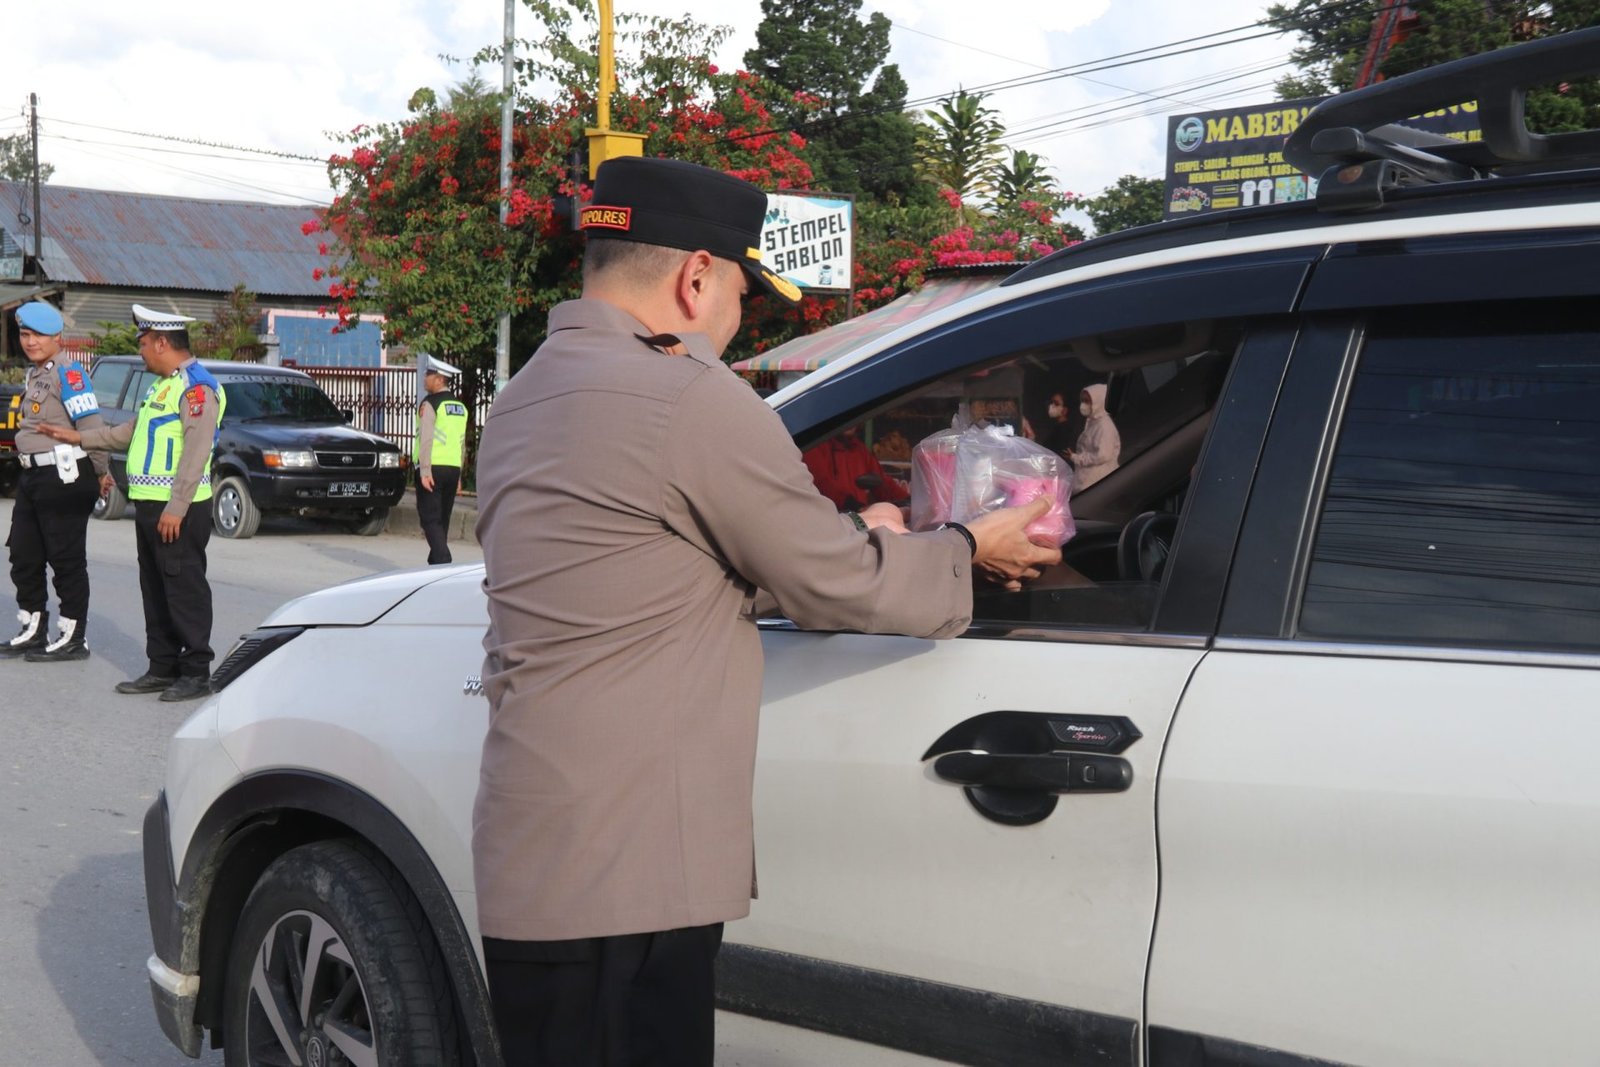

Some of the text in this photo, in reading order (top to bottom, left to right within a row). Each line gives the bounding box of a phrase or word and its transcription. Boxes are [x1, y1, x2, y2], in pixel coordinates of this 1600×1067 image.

[1205, 106, 1316, 143] MABER'
[765, 213, 846, 252] STEMPEL
[774, 237, 843, 274] SABLON
[34, 381, 51, 391] POLRI
